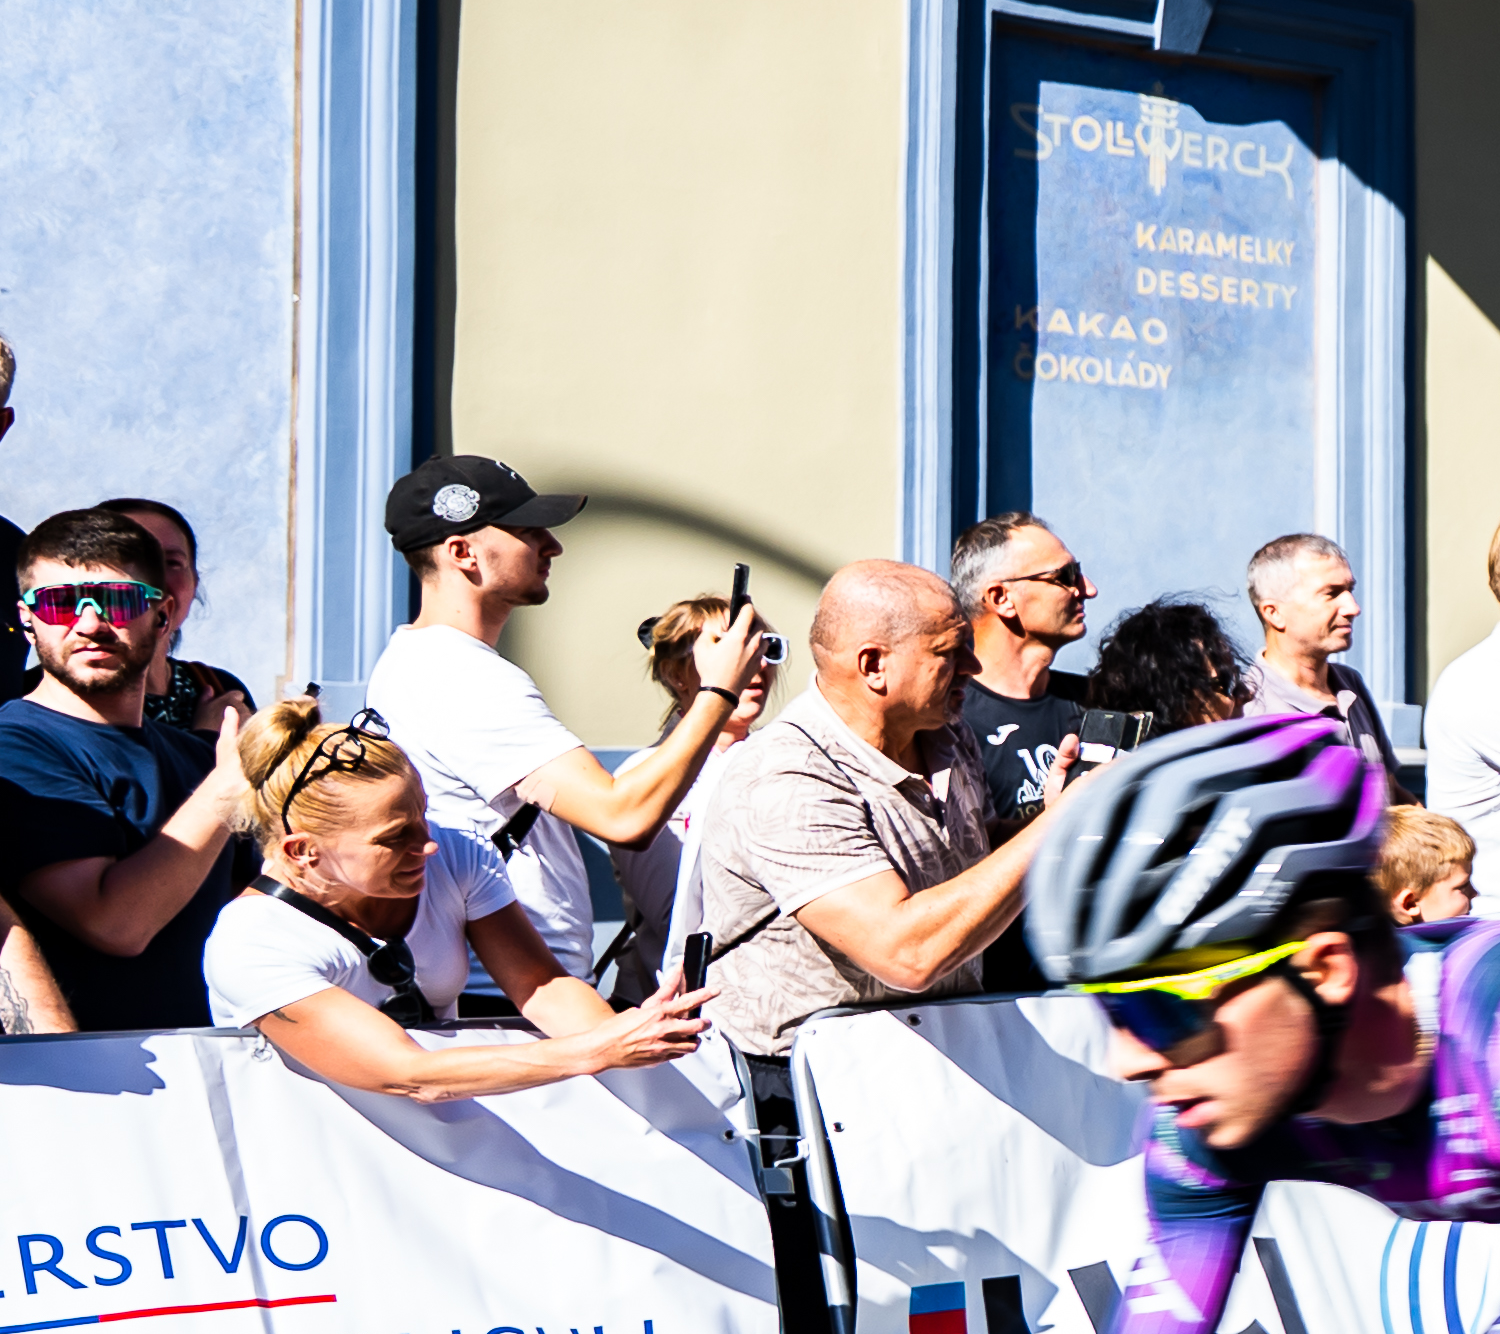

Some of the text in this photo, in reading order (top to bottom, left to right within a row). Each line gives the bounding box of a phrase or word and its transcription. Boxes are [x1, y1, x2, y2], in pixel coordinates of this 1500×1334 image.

[1136, 222, 1297, 267] KARAMELKY
[1136, 267, 1299, 311] DESSERTY
[1014, 304, 1168, 346] KAKAO
[0, 1212, 331, 1298] RSTVO
